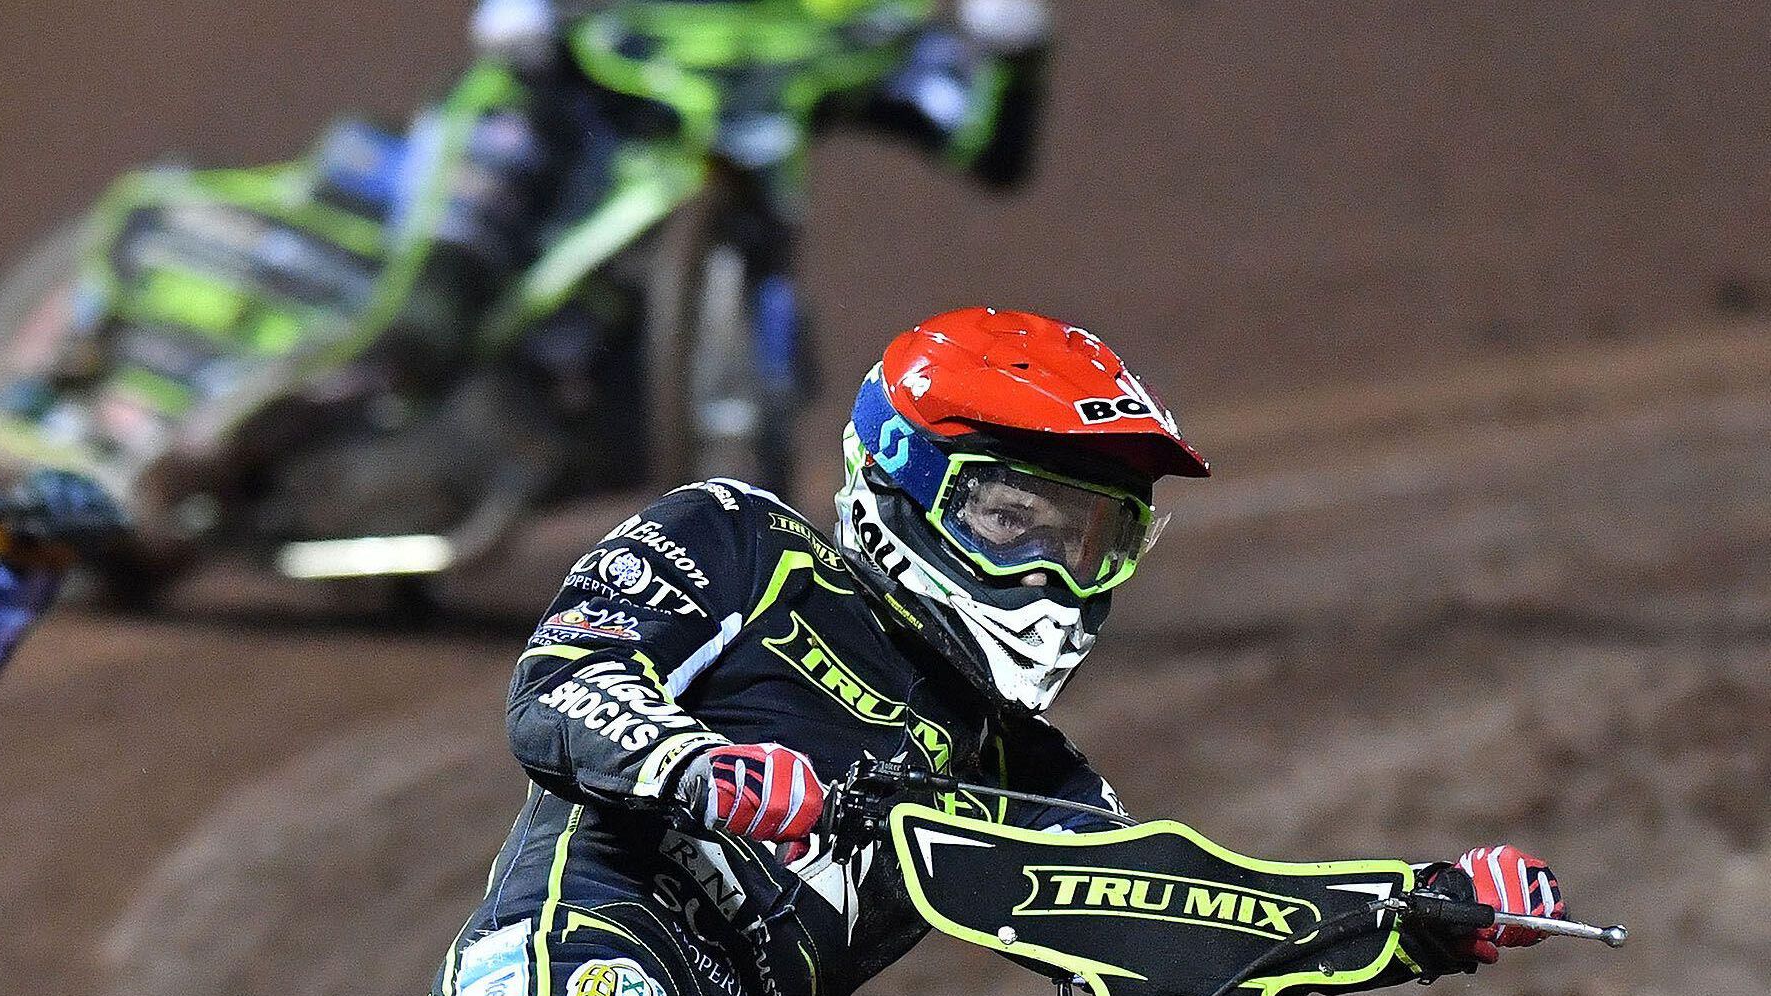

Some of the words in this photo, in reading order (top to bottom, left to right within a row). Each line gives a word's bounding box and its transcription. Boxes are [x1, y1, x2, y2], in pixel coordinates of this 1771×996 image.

[570, 548, 708, 618] COTT
[628, 520, 710, 590] Euston
[800, 637, 906, 721] TRU
[538, 680, 660, 751] SHOCKS
[1050, 875, 1175, 911] TRU
[1183, 886, 1300, 935] MIX
